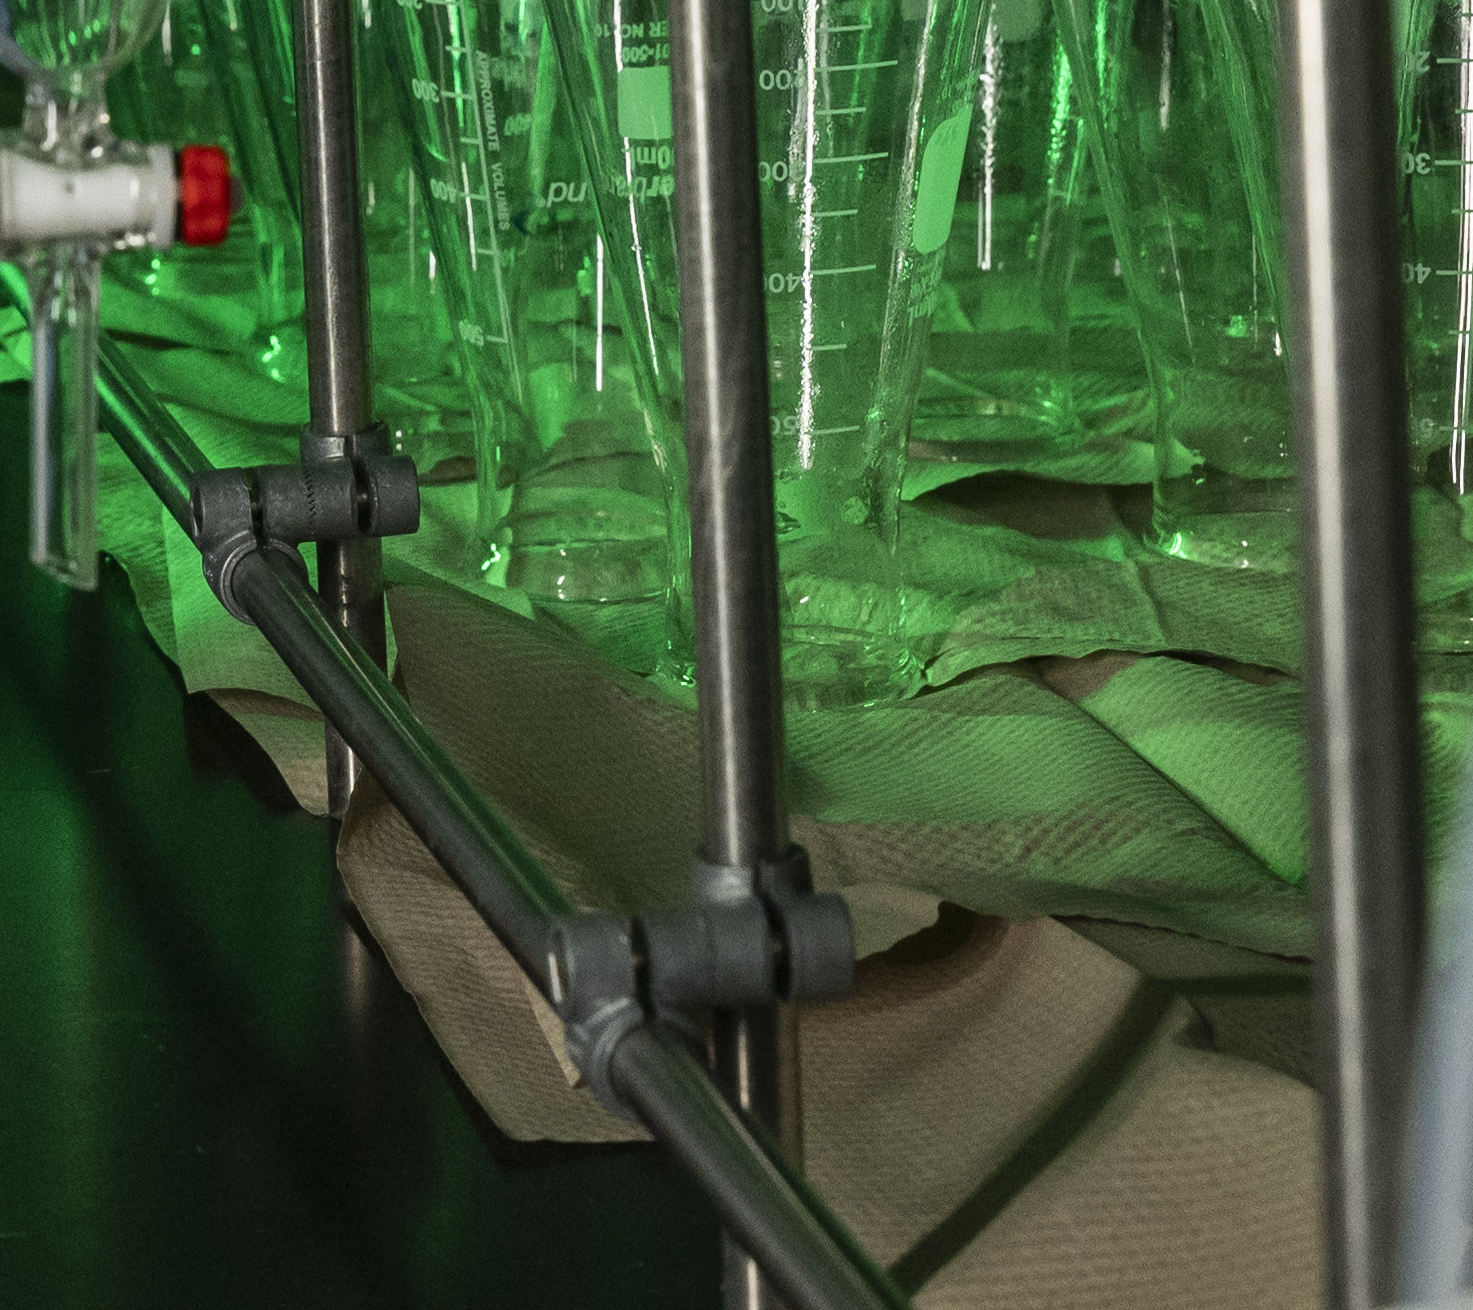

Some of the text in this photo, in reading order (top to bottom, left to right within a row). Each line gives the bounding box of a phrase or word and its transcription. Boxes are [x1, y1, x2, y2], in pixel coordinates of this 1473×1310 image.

[475, 50, 511, 232] APPROXIMATE VOLUMES
[763, 272, 804, 293] 40
